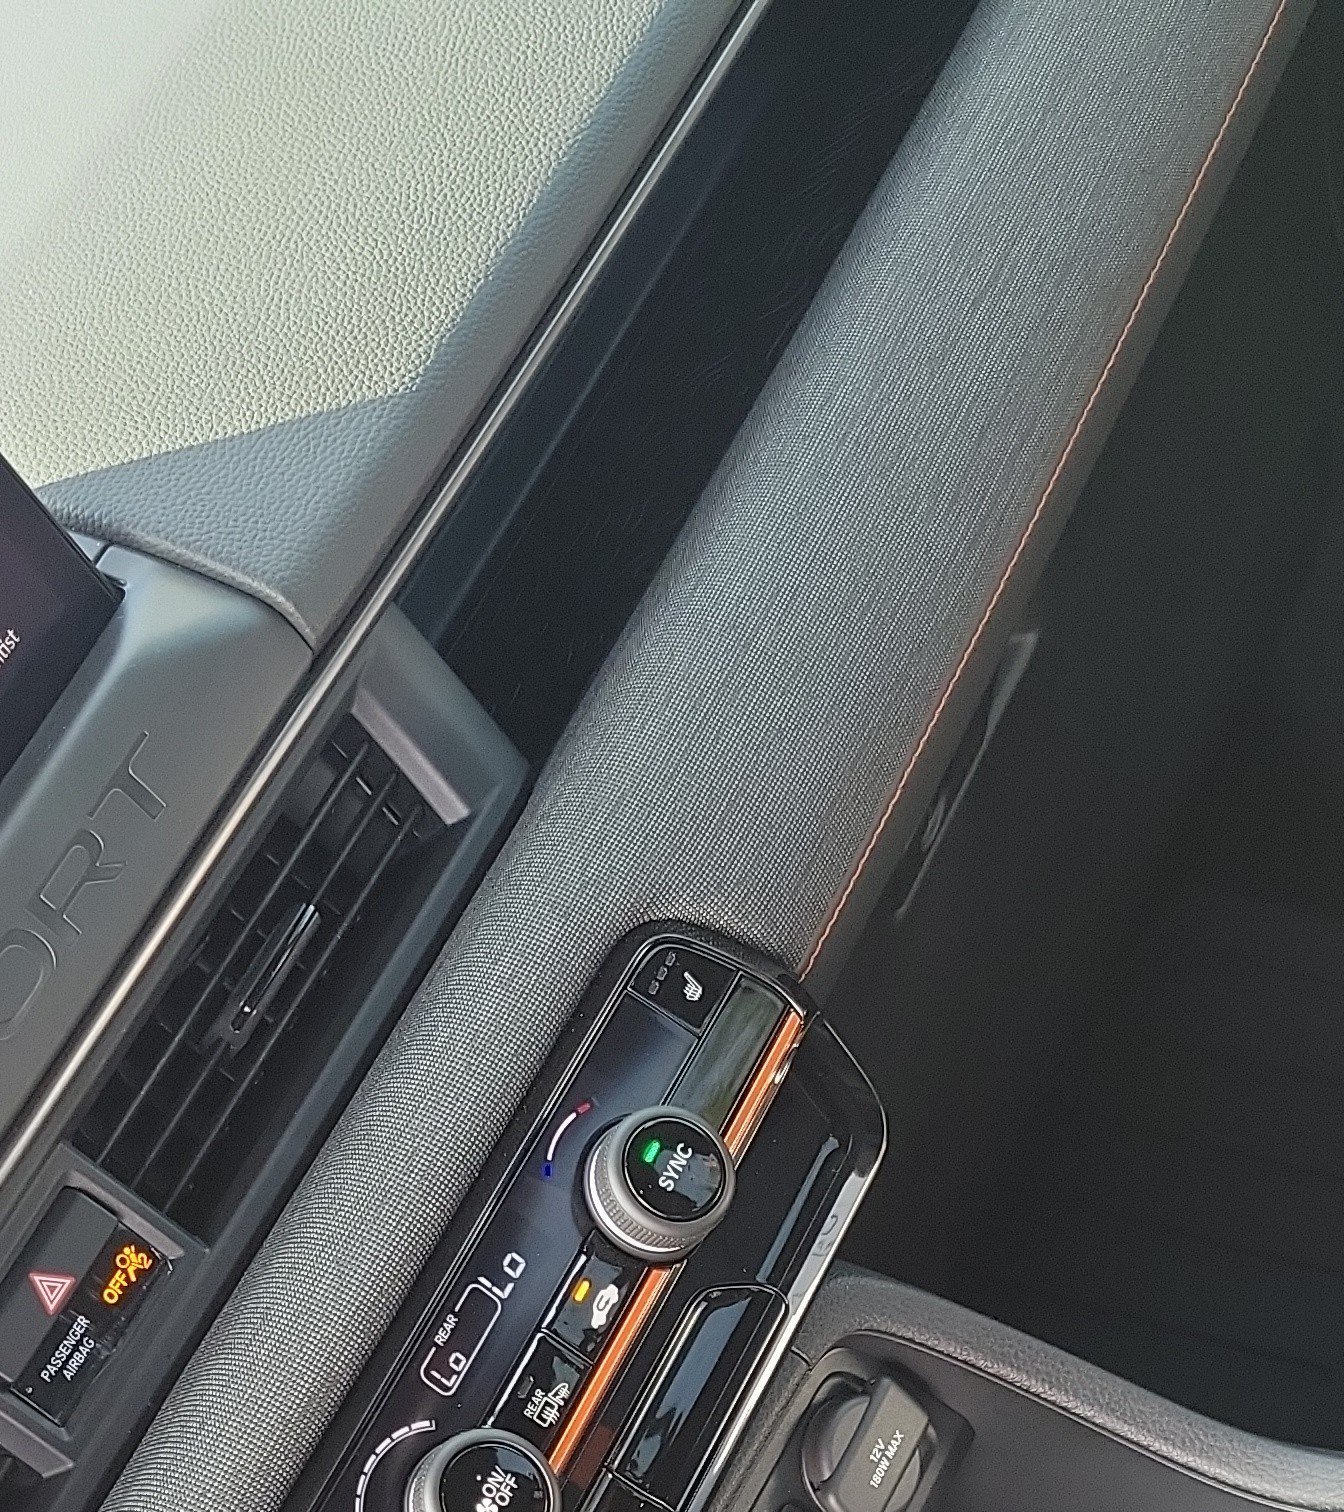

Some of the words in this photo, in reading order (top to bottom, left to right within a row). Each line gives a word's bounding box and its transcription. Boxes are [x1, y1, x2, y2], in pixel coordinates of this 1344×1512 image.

[658, 1141, 694, 1192] SYNC
[103, 1269, 129, 1305] OFF
[434, 1313, 460, 1346] REAR
[41, 1315, 91, 1383] PASSENGER
[62, 1336, 95, 1382] AIRBAG
[523, 1388, 547, 1419] REAR
[869, 1438, 887, 1464] 12V
[869, 1459, 891, 1489] 180W
[884, 1429, 905, 1460] MAX
[482, 1465, 507, 1499] ON/
[494, 1475, 518, 1509] OFF
